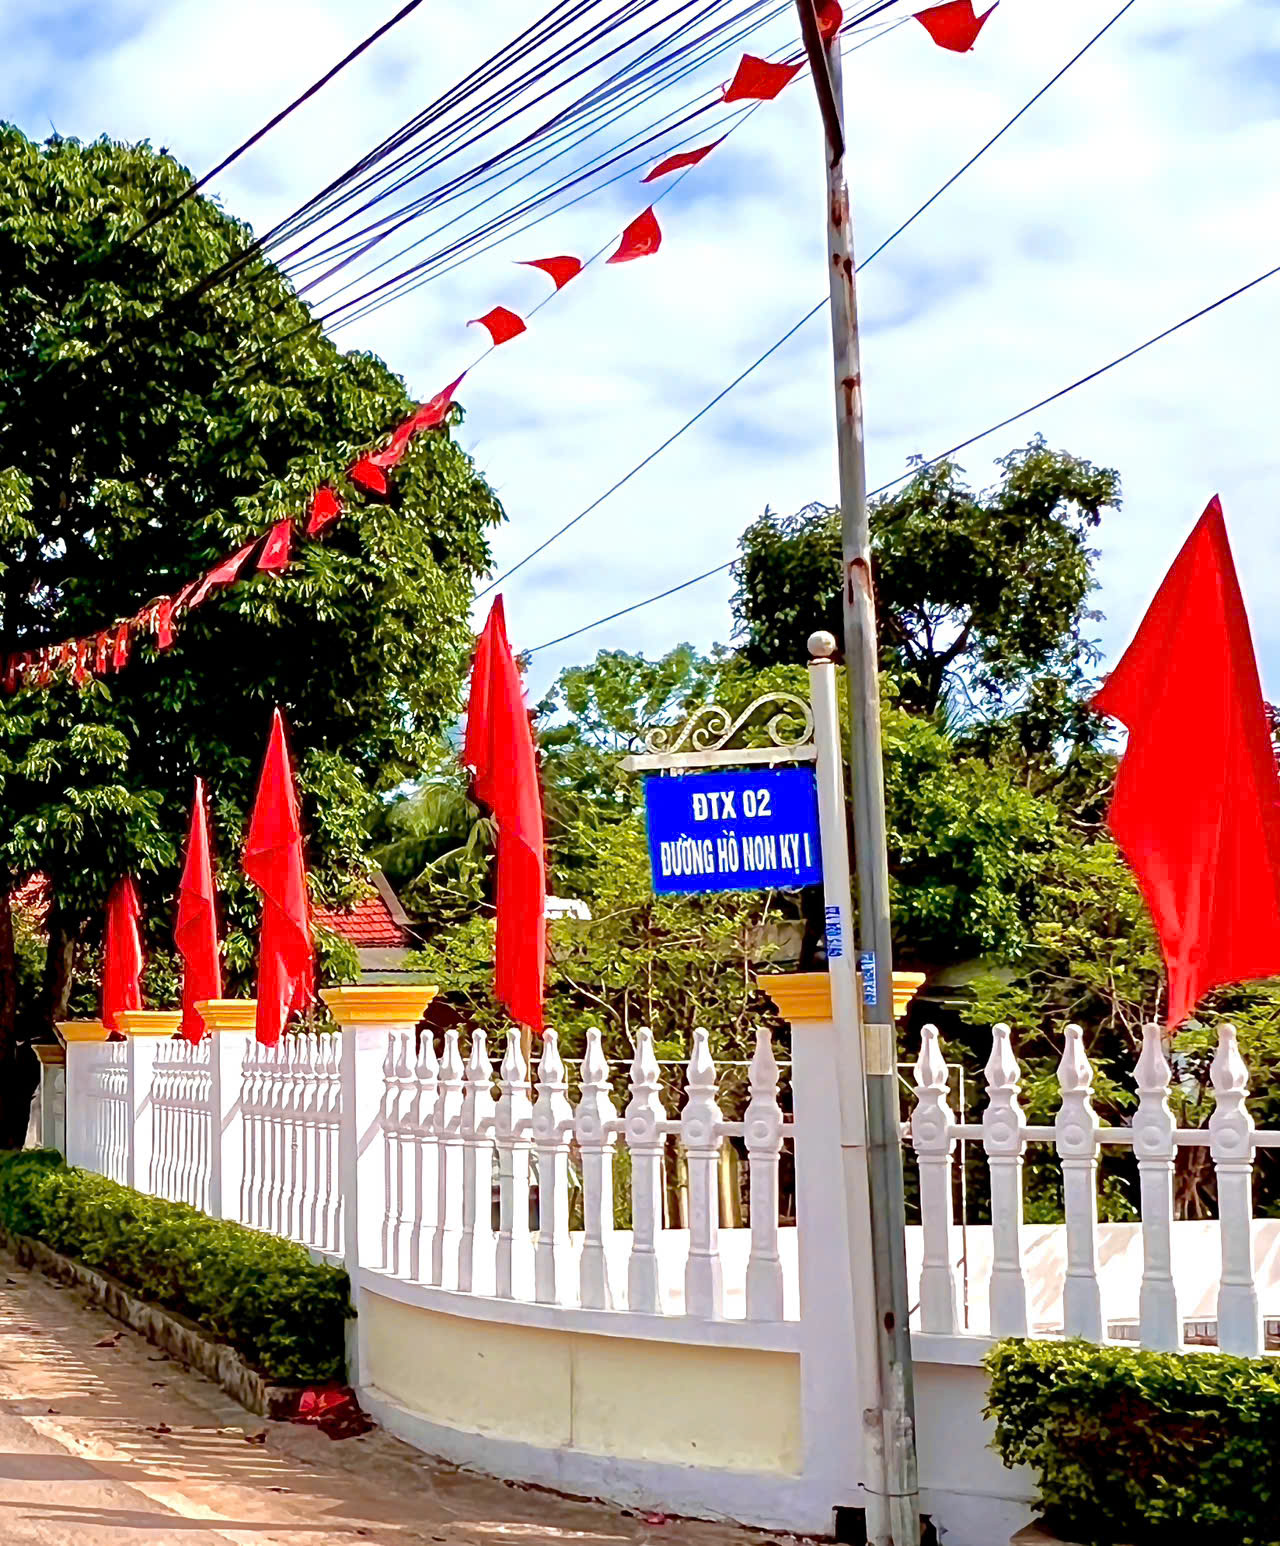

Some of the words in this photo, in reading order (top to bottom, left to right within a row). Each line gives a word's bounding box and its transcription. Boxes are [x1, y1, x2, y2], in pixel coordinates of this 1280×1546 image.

[692, 791, 737, 821] ĐTX
[742, 788, 772, 818] 02
[660, 832, 715, 877] ĐƯỜNG
[716, 829, 740, 873] HỒ
[741, 835, 777, 872] NON
